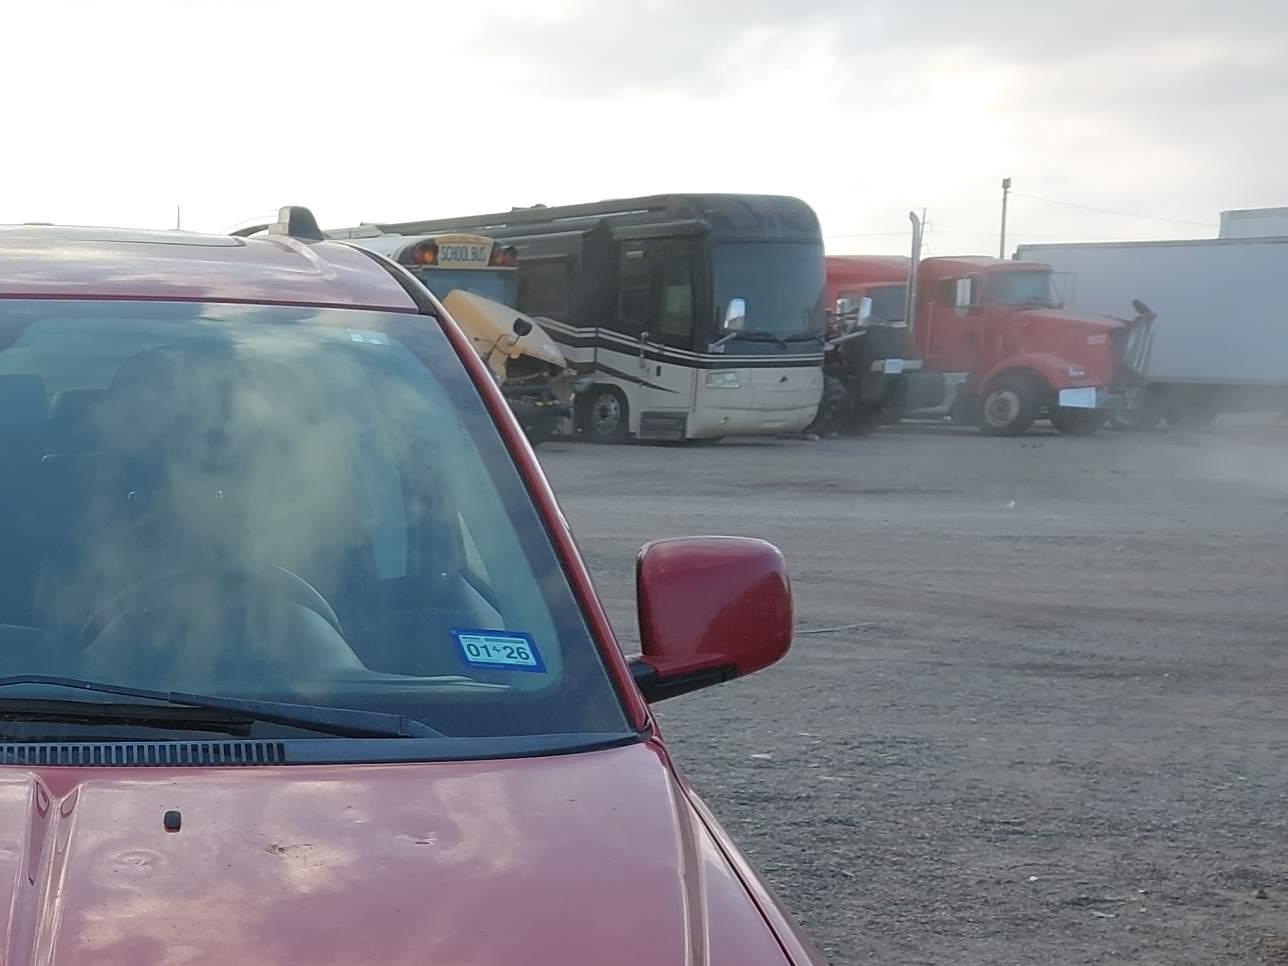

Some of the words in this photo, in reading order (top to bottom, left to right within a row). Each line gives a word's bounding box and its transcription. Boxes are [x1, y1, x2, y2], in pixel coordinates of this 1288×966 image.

[441, 245, 470, 262] SCHOOL
[471, 245, 487, 262] BUS
[466, 643, 492, 658] 01
[502, 646, 530, 661] 26
